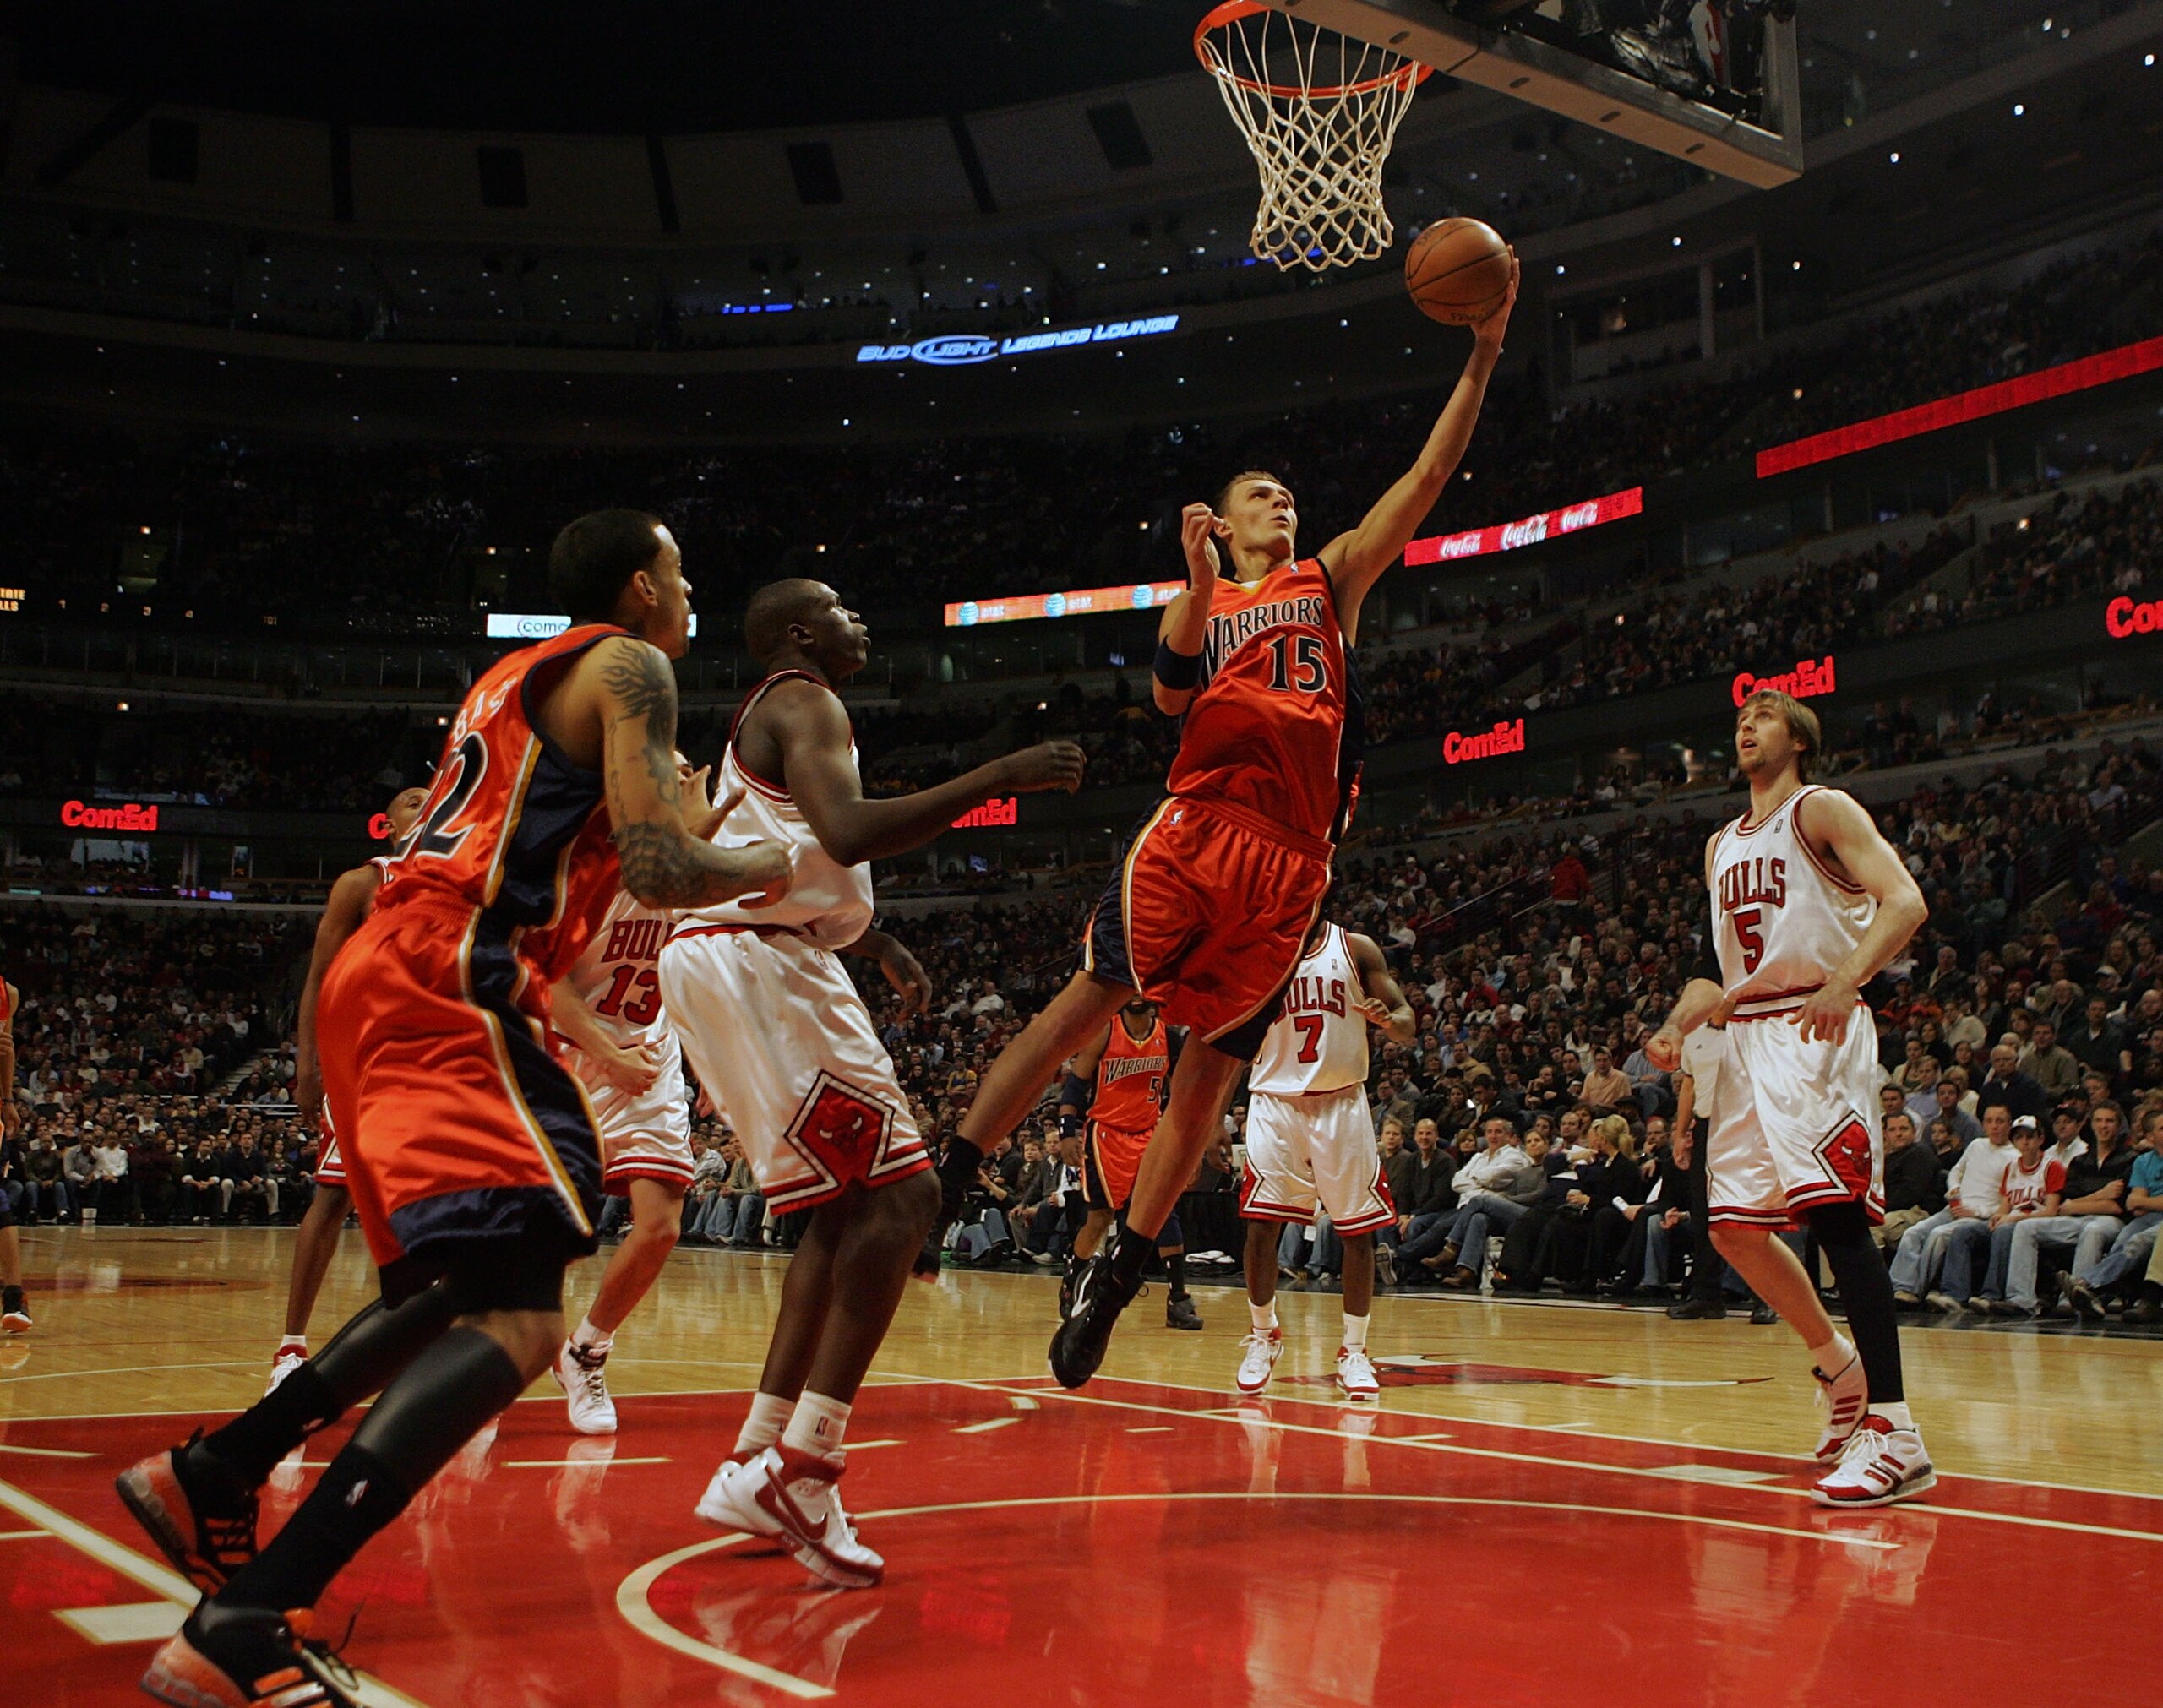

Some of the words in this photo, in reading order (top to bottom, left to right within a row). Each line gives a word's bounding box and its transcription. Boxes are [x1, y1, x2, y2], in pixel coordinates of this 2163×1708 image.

[856, 345, 911, 363] BUD
[924, 340, 999, 357] LIGHT
[1000, 327, 1092, 355] LEGENDS
[1092, 313, 1180, 342] LOUNGE
[1267, 635, 1327, 694] 15
[1442, 717, 1526, 765] ComEd
[61, 800, 159, 831] ComEd
[951, 797, 1018, 829] mEd
[1733, 908, 1763, 974] 5
[596, 964, 662, 1026] 13
[1294, 1014, 1324, 1063] 7
